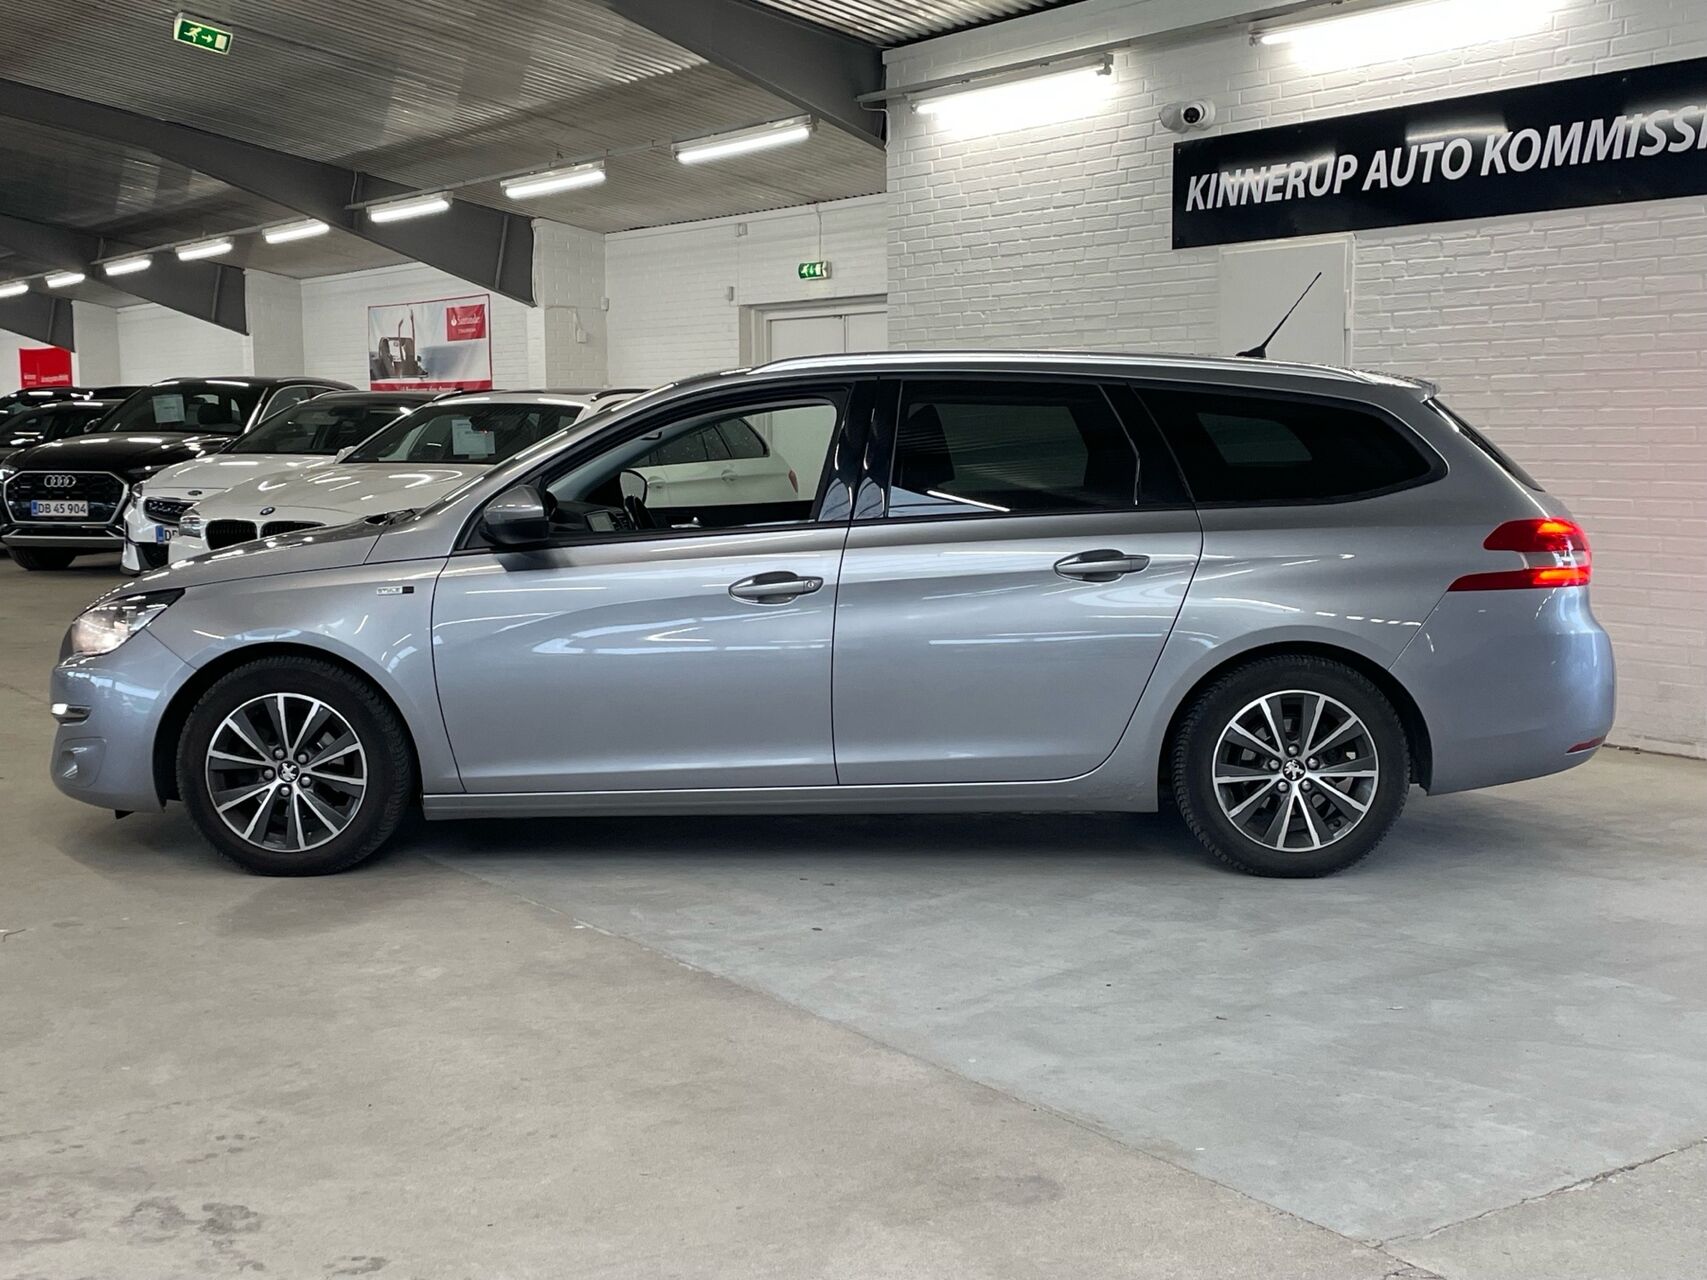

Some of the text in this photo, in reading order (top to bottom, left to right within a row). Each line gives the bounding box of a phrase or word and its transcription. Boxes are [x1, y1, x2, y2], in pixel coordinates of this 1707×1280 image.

[1185, 155, 1358, 212] KINNERUP
[1362, 139, 1473, 192] AUTO
[38, 503, 86, 514] DB 45 904
